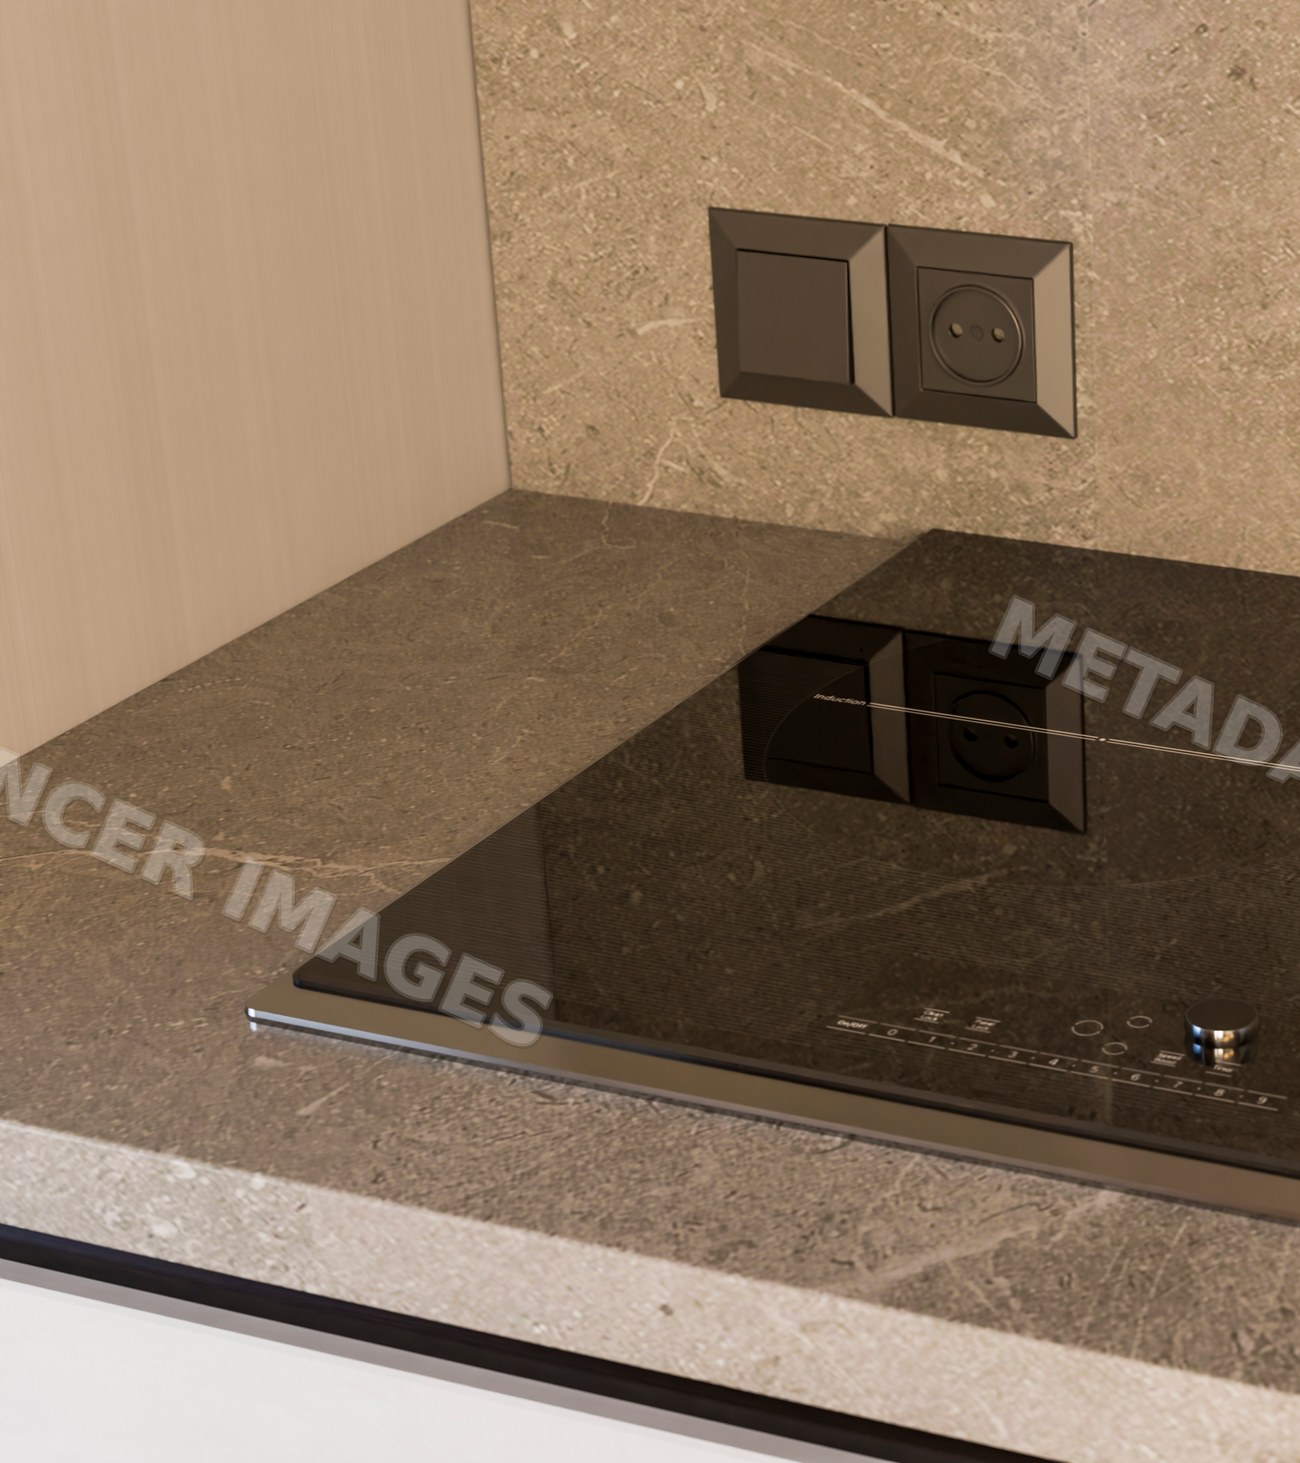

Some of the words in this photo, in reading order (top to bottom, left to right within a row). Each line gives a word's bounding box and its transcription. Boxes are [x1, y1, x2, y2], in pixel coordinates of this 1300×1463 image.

[813, 693, 867, 706] Induction
[966, 1043, 979, 1051] 2
[1007, 1050, 1019, 1059] 3
[1048, 1058, 1060, 1066] 4
[1089, 1065, 1100, 1074] 5
[1130, 1073, 1142, 1082] 6
[1256, 1096, 1268, 1105] 9
